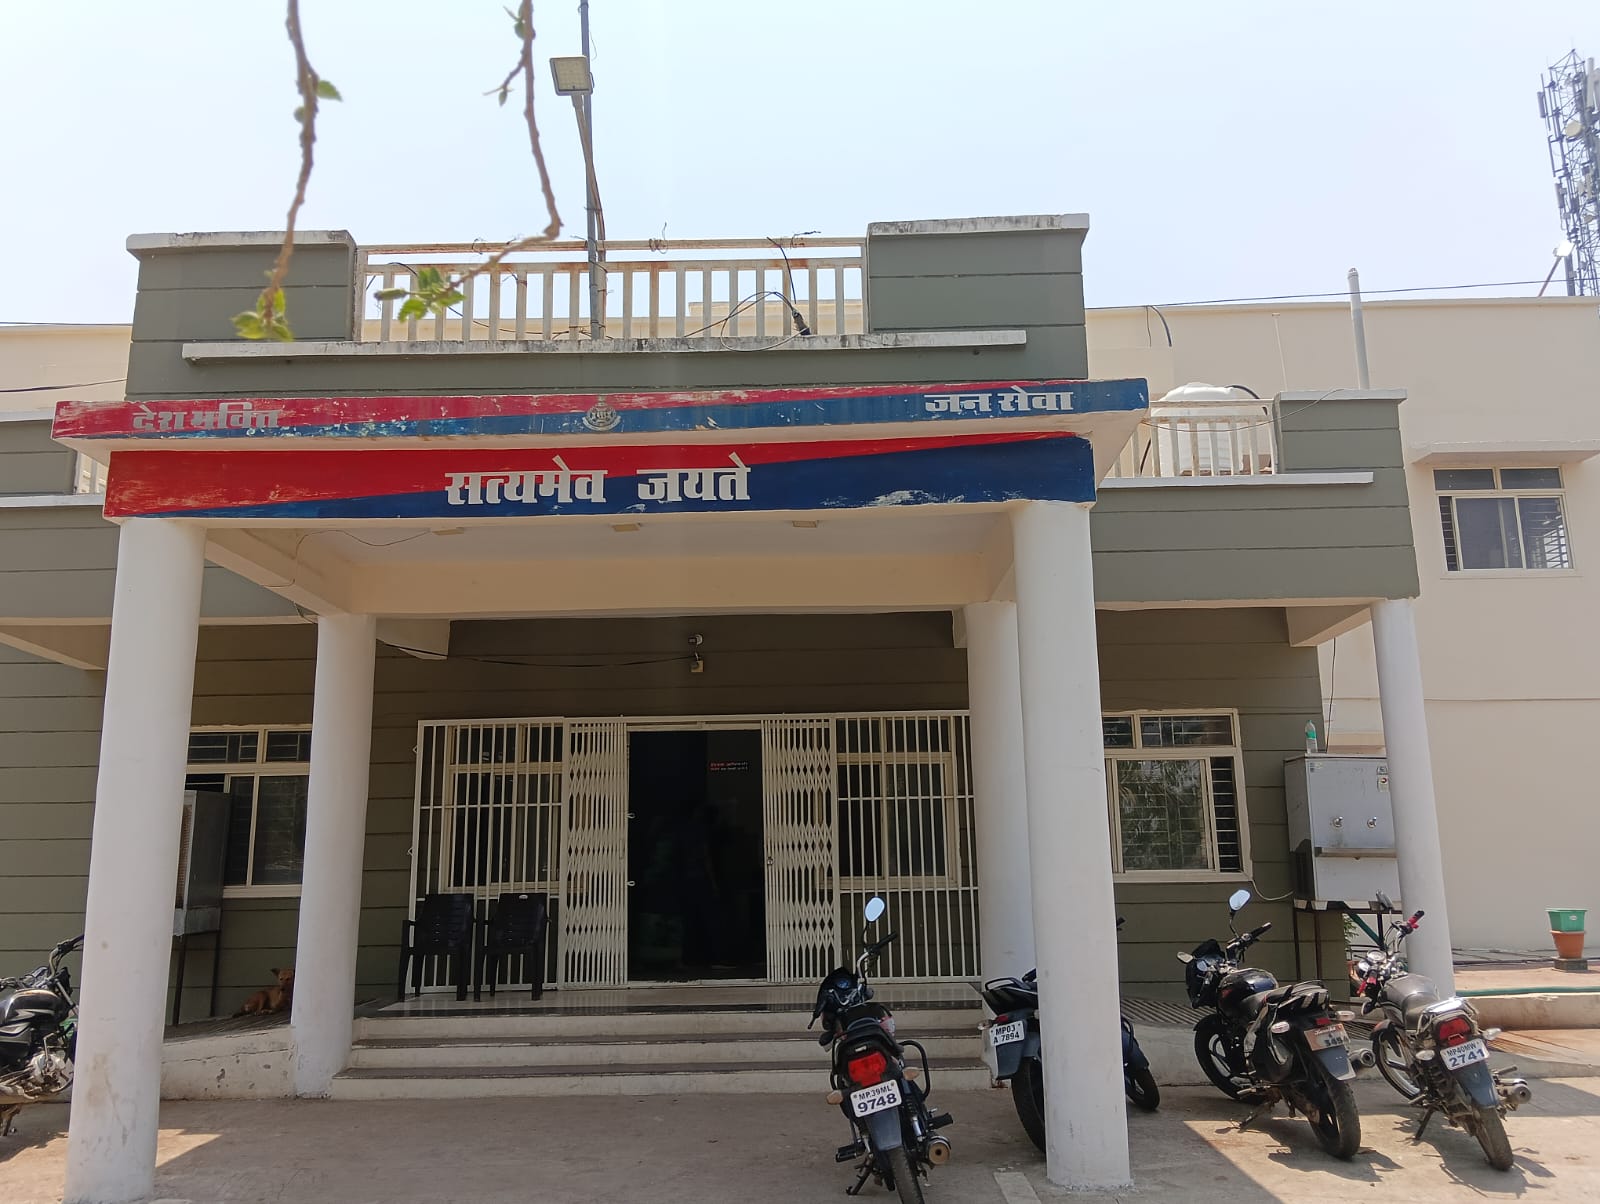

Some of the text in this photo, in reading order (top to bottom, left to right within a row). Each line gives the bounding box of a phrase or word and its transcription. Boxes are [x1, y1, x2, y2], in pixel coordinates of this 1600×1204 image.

[924, 385, 1074, 413] जन सेवा
[132, 402, 282, 431] देश भक्ति
[444, 451, 752, 505] सत्यमेव जयते
[993, 1031, 1020, 1044] A 7894
[995, 1024, 1016, 1036] MP03
[1449, 1048, 1485, 1068] 2741
[857, 1093, 897, 1113] 9748
